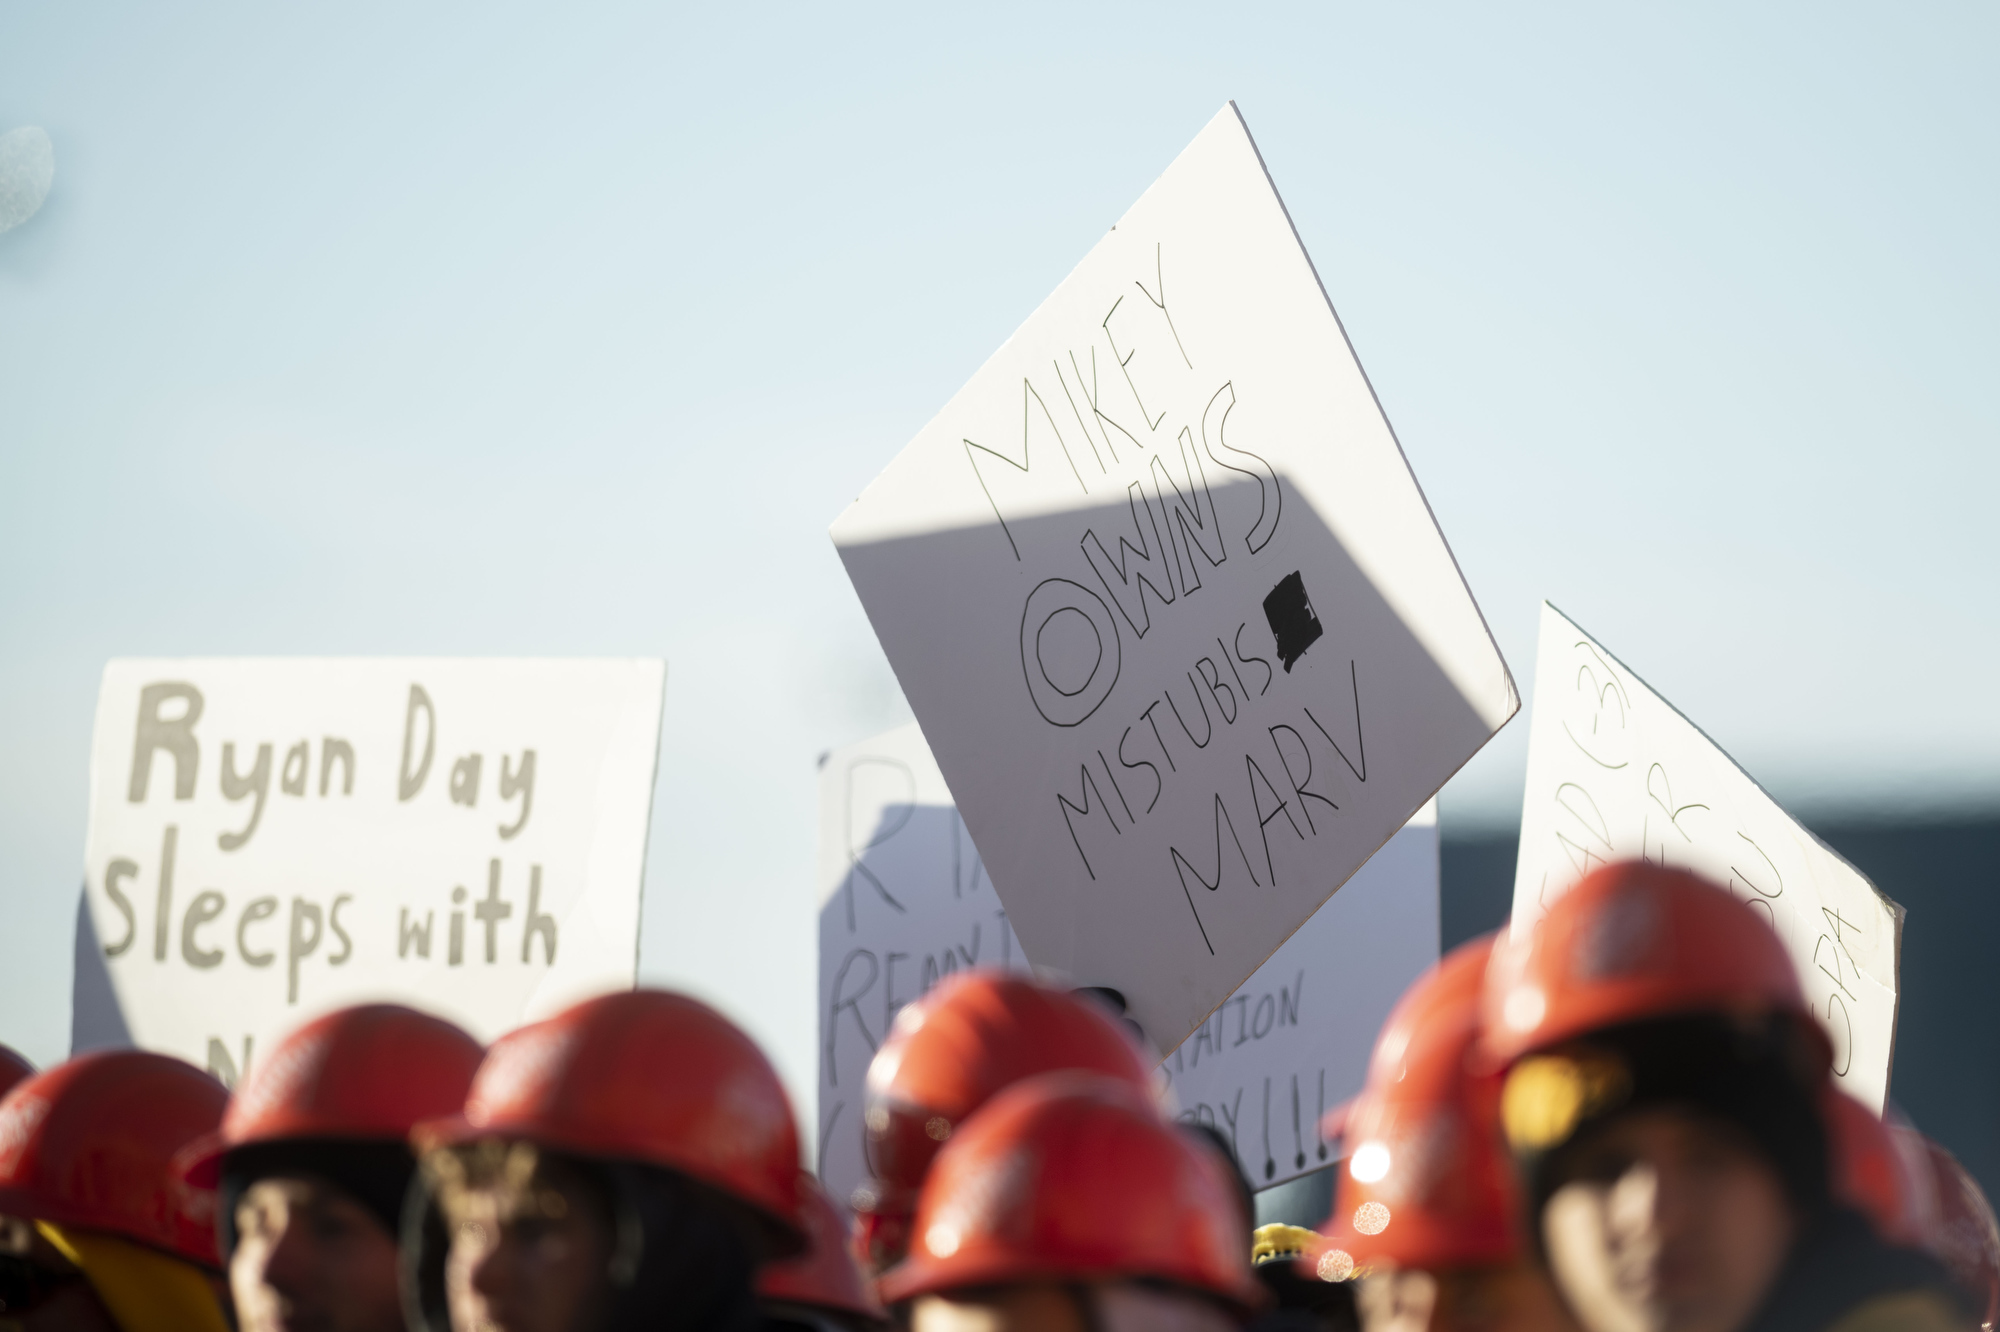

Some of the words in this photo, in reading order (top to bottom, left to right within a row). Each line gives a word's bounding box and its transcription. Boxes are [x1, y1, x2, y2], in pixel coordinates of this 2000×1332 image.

[963, 243, 1192, 561] MIKEY
[1021, 380, 1282, 727] OWNS
[127, 680, 357, 852] Ryan
[399, 683, 537, 841] Day
[1170, 659, 1366, 956] MARV
[103, 825, 355, 1006] Sleeps
[398, 858, 558, 968] with
